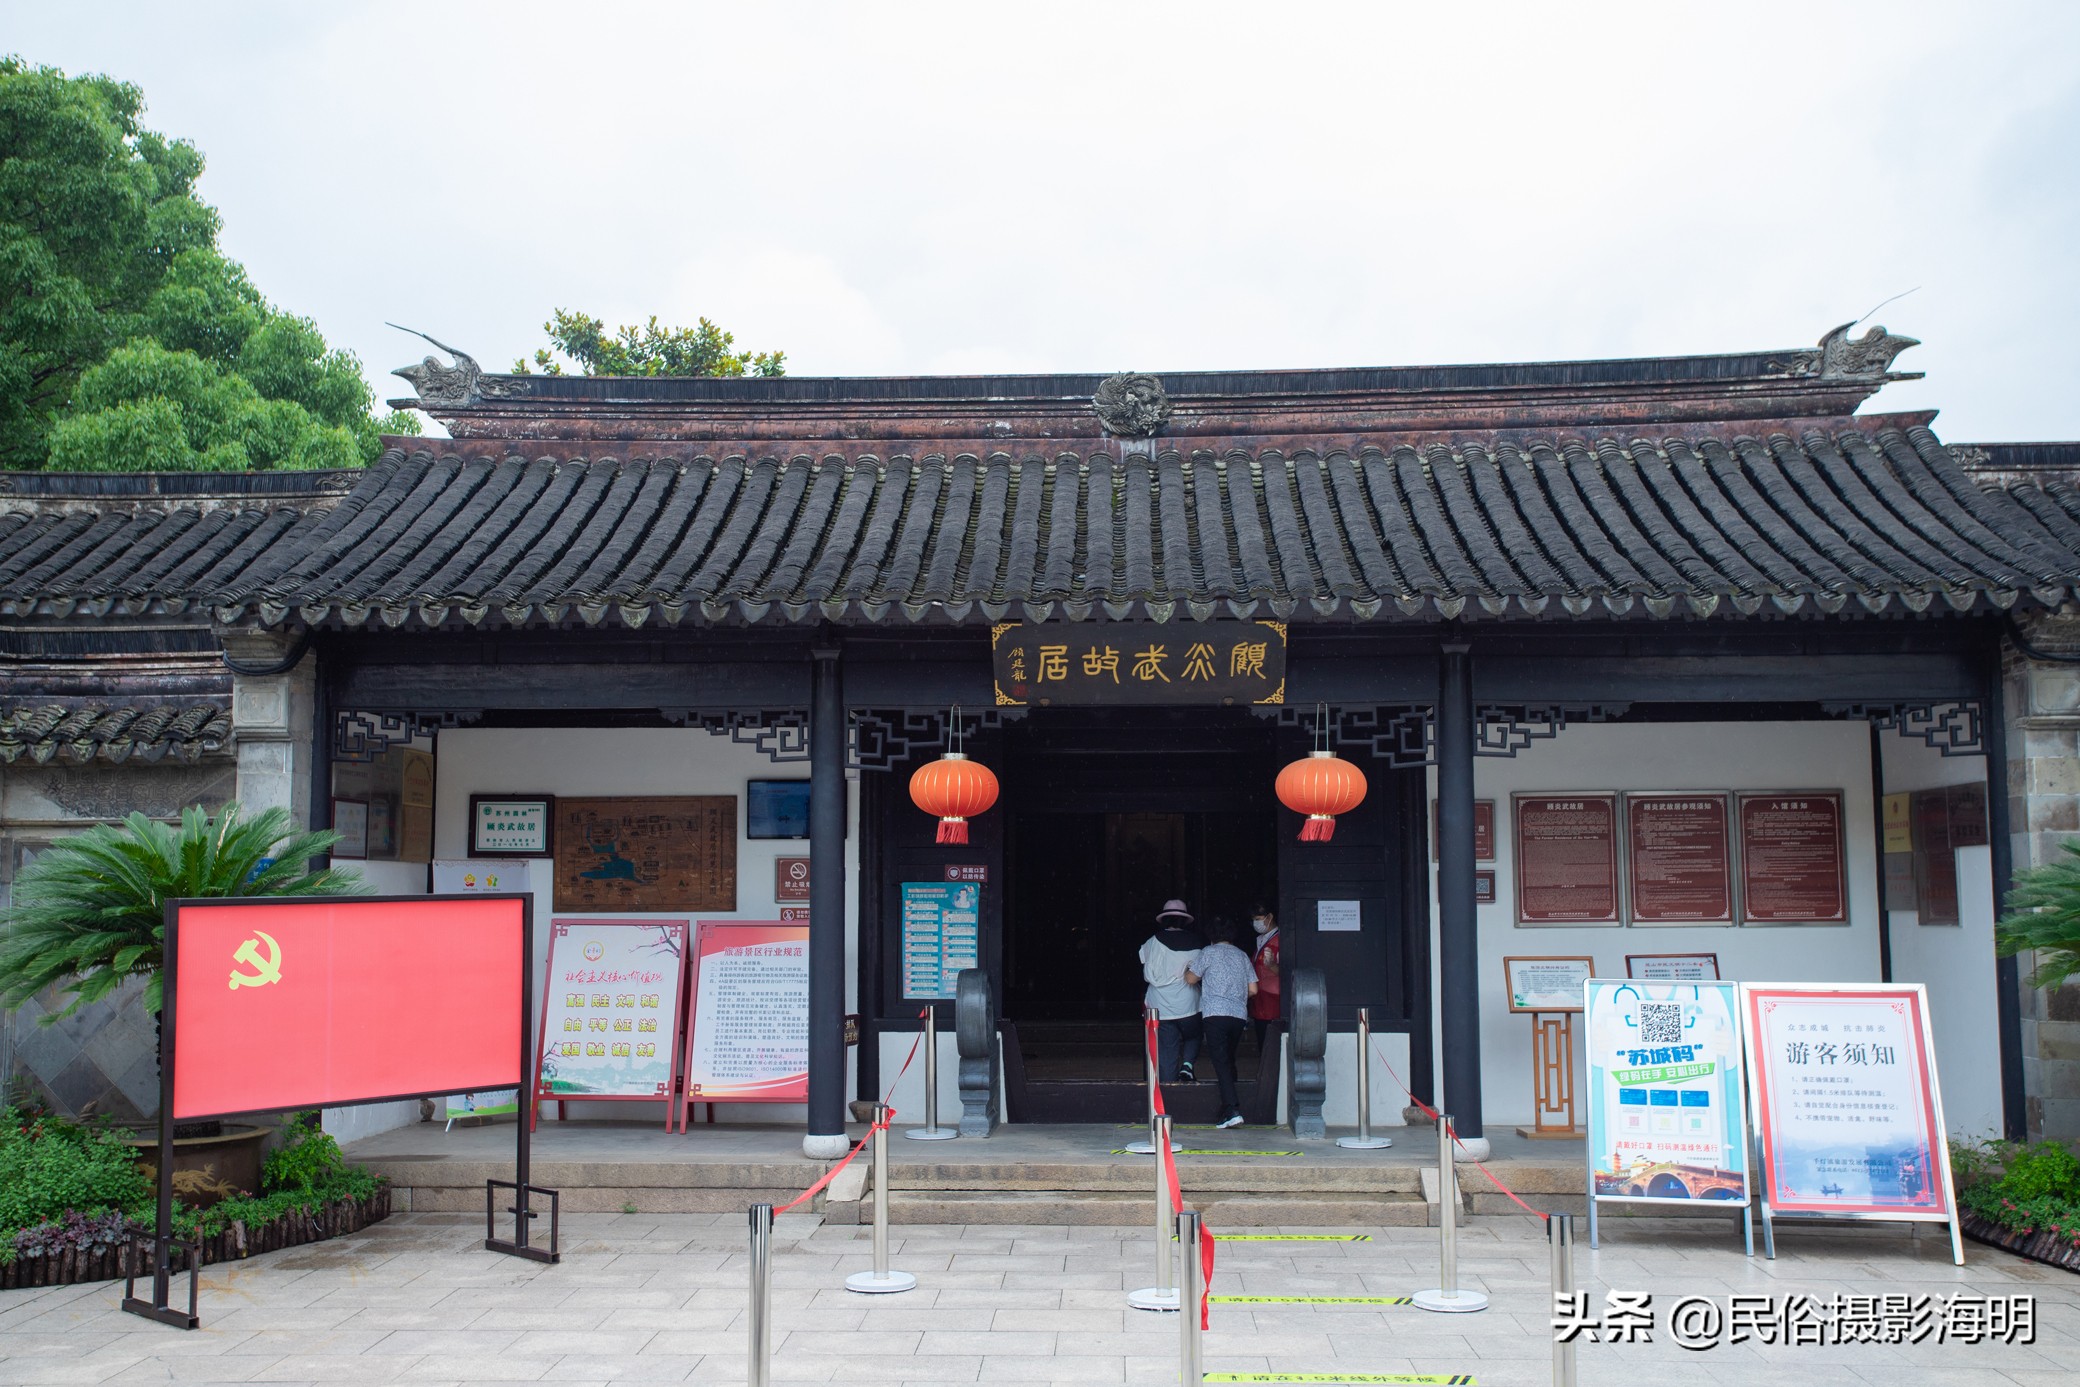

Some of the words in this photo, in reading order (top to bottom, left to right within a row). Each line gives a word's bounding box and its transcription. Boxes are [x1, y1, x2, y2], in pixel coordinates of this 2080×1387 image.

[724, 947, 802, 957] 旅游景区行业规范
[566, 993, 585, 1008] 富强
[591, 994, 610, 1008] 民主
[616, 994, 635, 1008] 文明
[640, 994, 659, 1008] 和谐
[564, 1018, 582, 1032] 自由
[589, 1018, 608, 1032] 平等
[614, 1018, 632, 1032] 公正
[638, 1018, 657, 1032] 法治
[562, 1042, 580, 1056] 爱国
[586, 1042, 605, 1056] 敬业
[612, 1042, 630, 1057] 诚信
[636, 1043, 655, 1057] 友善
[1786, 1042, 1895, 1066] 游客须知
[1620, 1069, 1662, 1082] 绿码在手
[1666, 1064, 1710, 1077] 安心出行
[1616, 1141, 1652, 1150] 请戴好口罩
[1657, 1142, 1718, 1152] 扫码测温绿色通行
